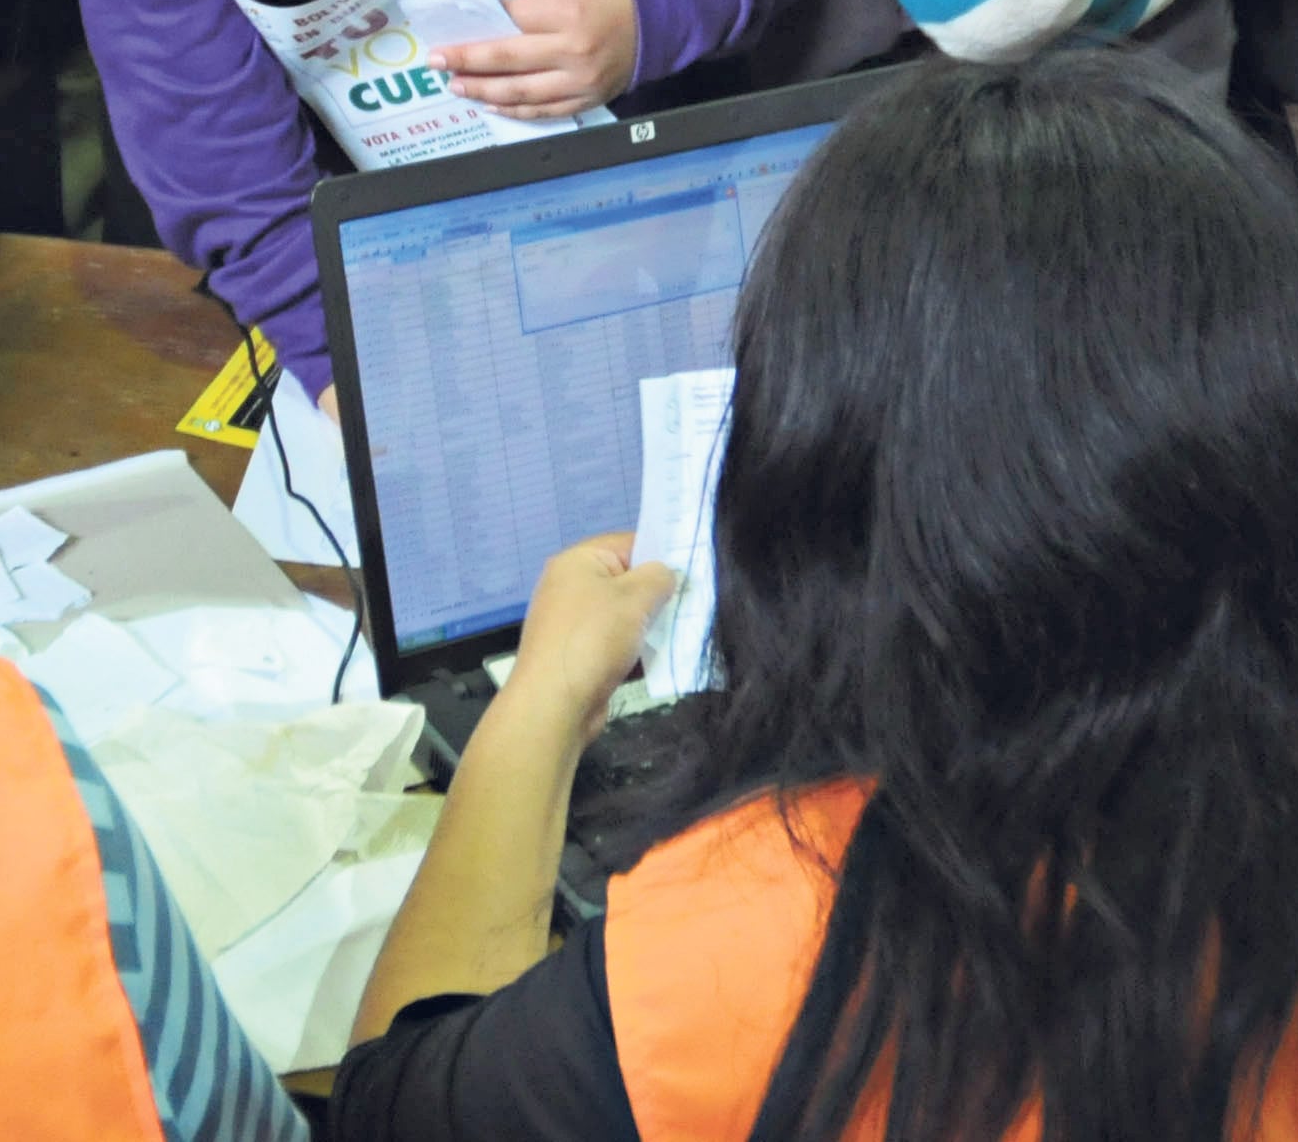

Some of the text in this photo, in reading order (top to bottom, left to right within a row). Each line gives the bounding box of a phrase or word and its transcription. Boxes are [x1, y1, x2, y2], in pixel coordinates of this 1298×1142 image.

[291, 27, 320, 43] EN
[328, 25, 419, 79] VO
[347, 64, 451, 113] CUE
[360, 129, 401, 148] VOTA
[407, 118, 443, 136] ESTE
